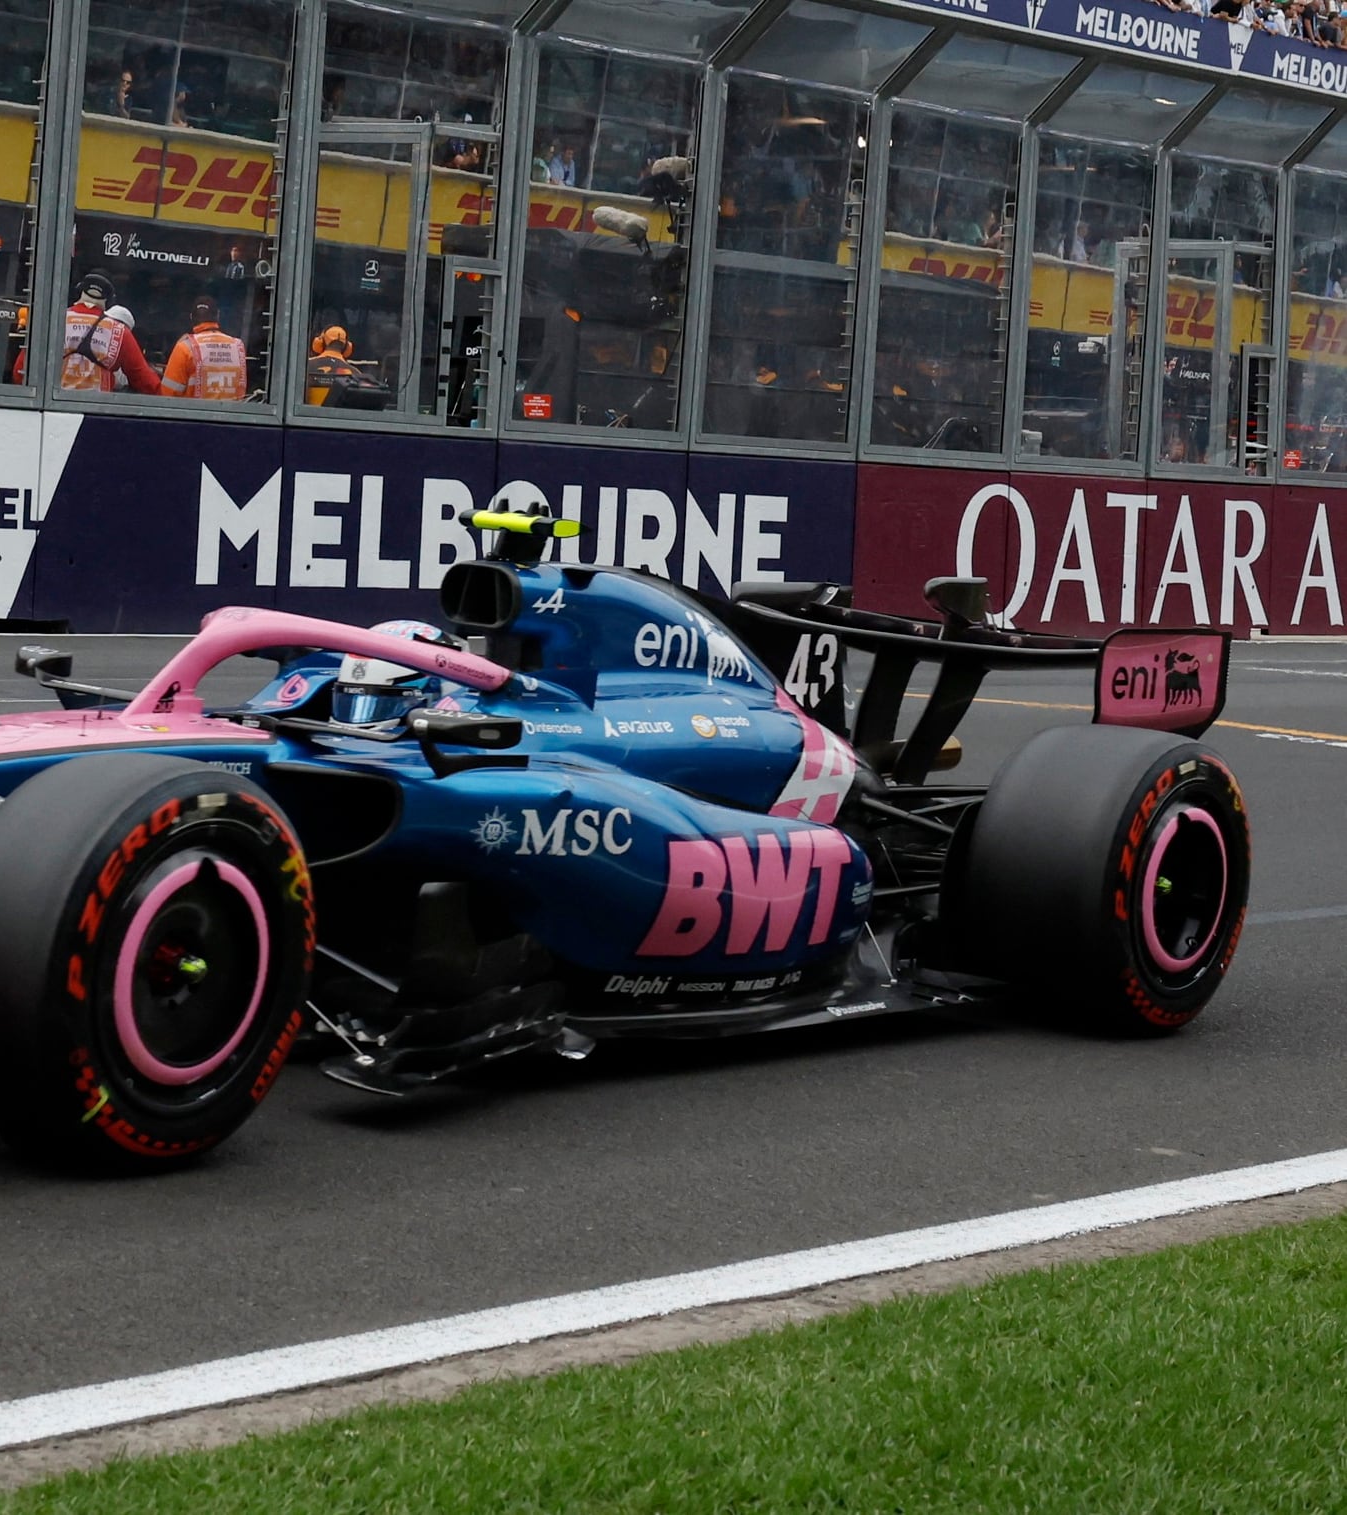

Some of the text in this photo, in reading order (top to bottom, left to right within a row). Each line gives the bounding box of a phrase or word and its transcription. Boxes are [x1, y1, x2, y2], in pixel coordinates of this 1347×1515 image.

[1075, 3, 1201, 59] MELBOURNE
[1229, 40, 1246, 56] MEL
[103, 232, 122, 256] 12
[126, 248, 210, 266] ANTONELLI
[956, 483, 1269, 631] QATAR
[634, 612, 696, 669] eni
[785, 633, 838, 709] 43
[1112, 655, 1159, 701] eni
[515, 807, 633, 857] MSC
[1120, 768, 1175, 886] ZERO
[79, 798, 181, 944] ZERO
[636, 826, 851, 957] BWT
[605, 975, 673, 996] Delphi
